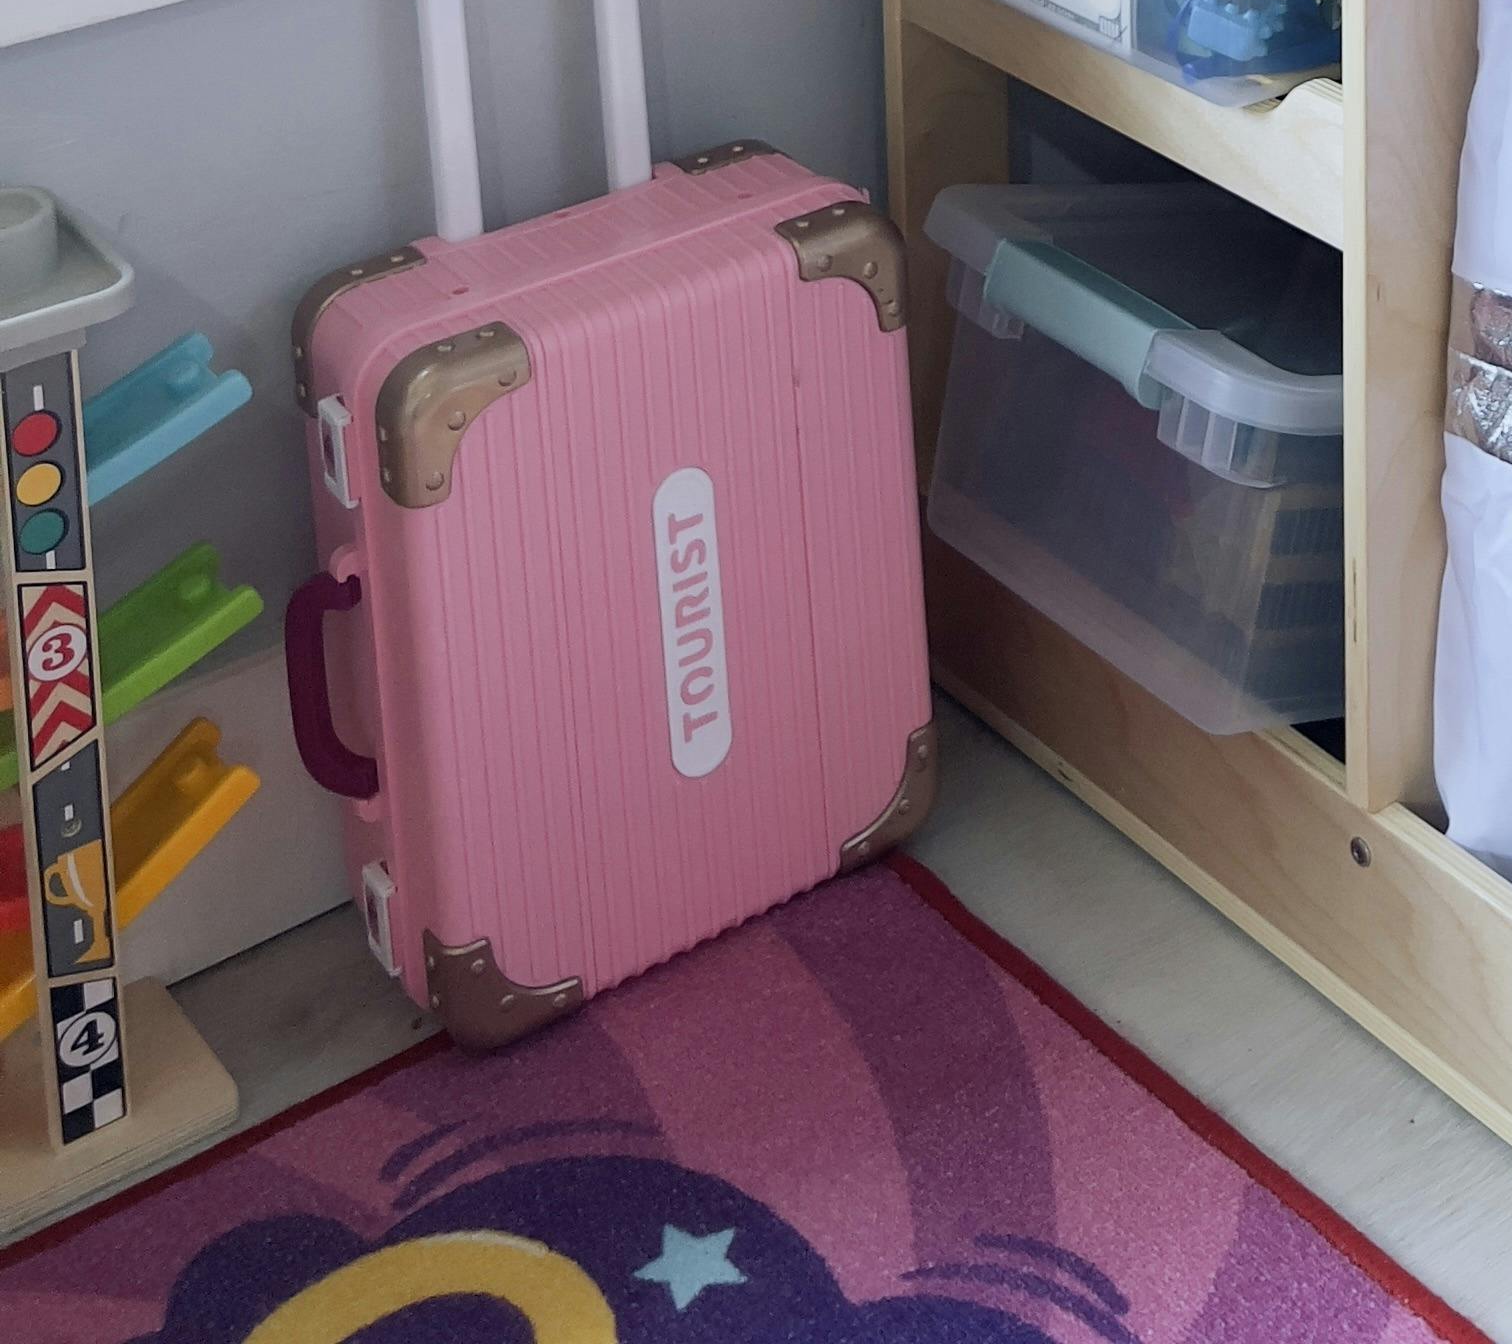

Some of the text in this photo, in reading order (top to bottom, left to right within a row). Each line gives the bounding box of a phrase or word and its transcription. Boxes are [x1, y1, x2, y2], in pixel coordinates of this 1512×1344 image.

[668, 512, 719, 744] TOURIST
[42, 631, 75, 671] 3
[71, 1018, 105, 1056] 4
